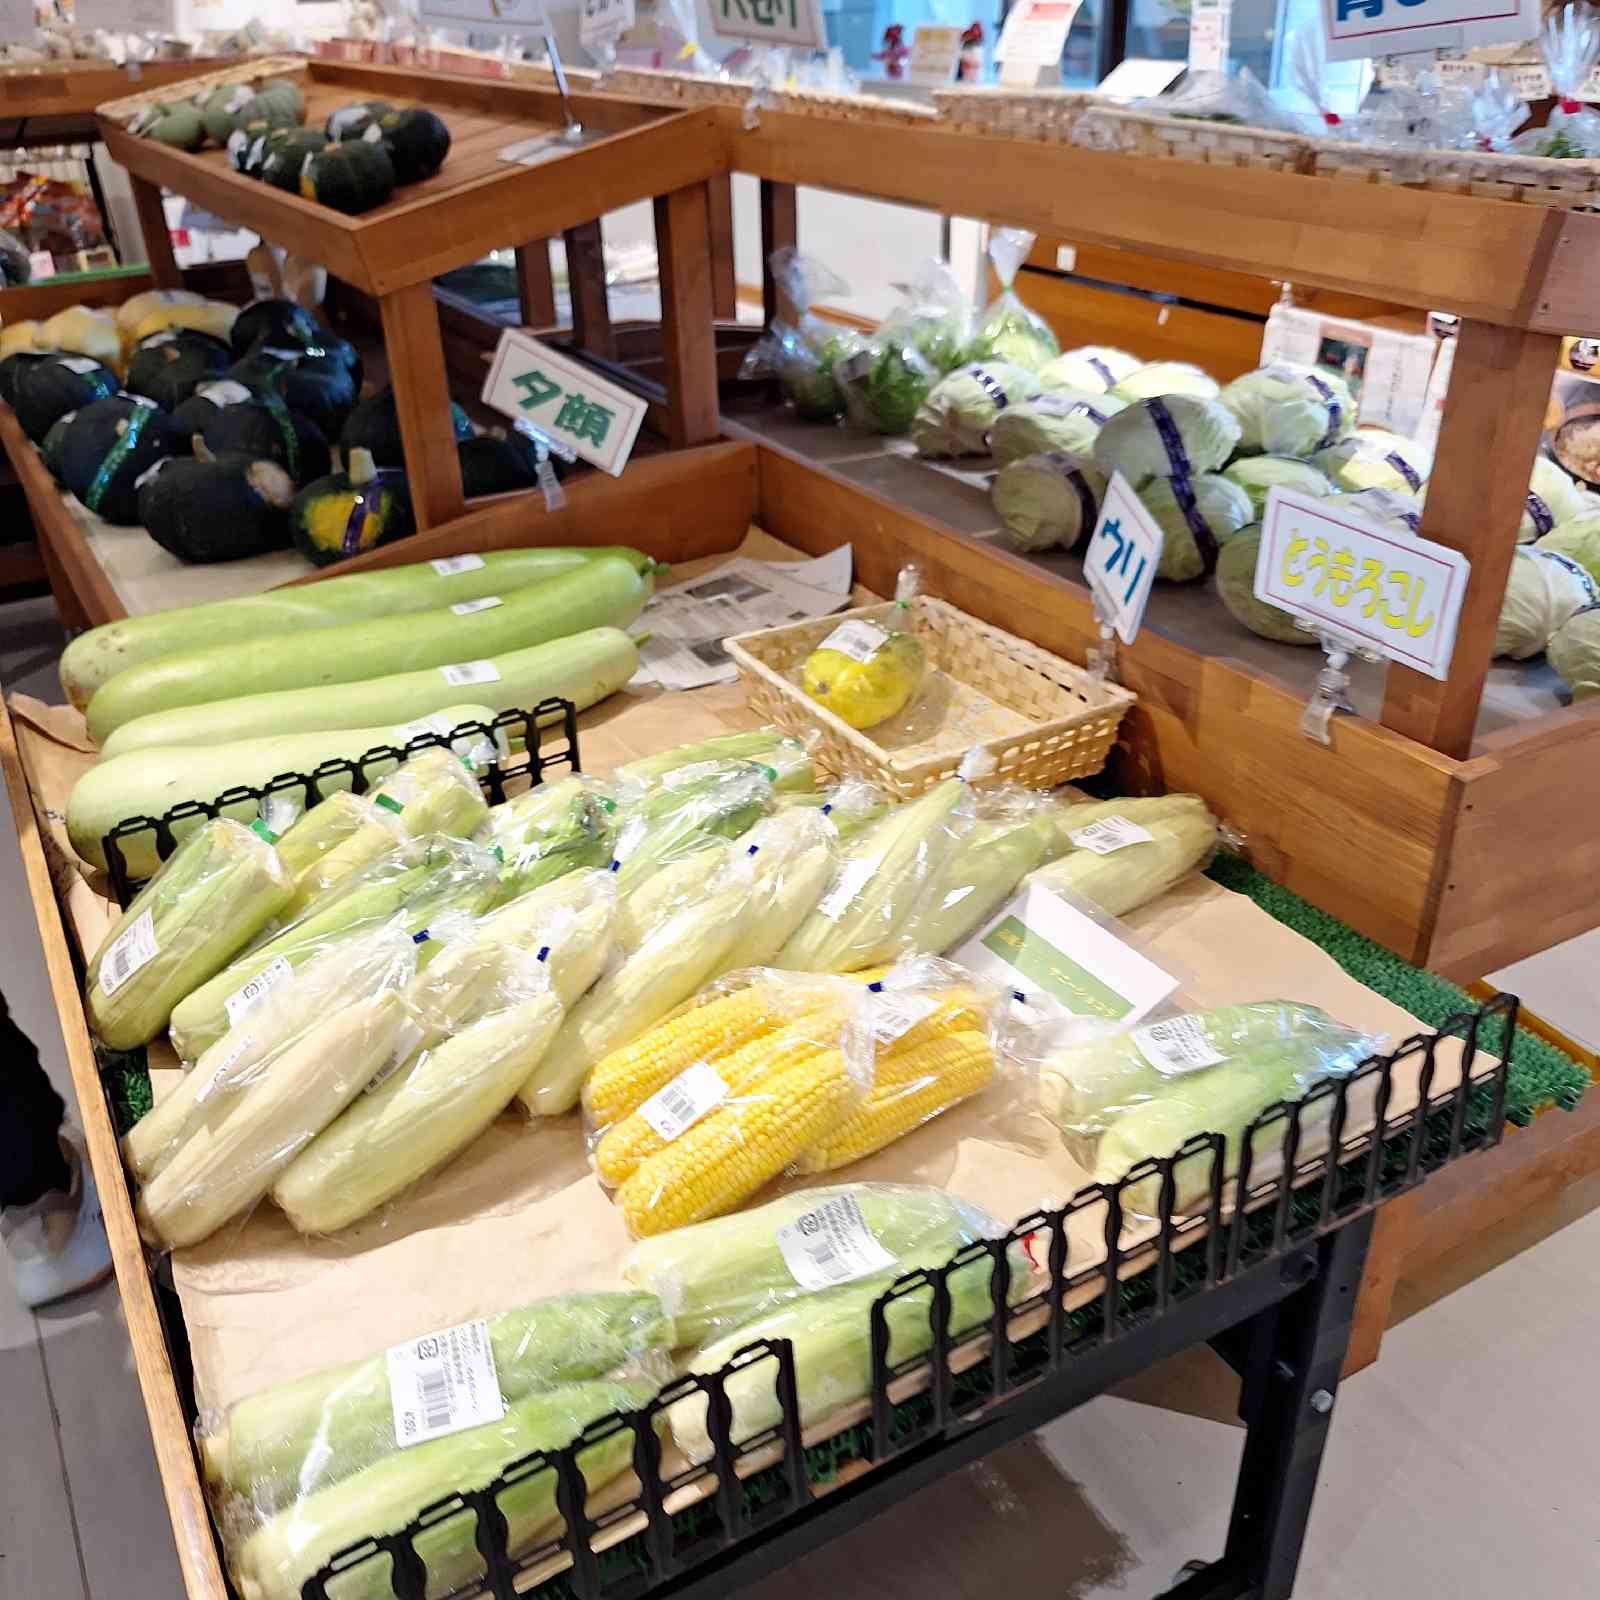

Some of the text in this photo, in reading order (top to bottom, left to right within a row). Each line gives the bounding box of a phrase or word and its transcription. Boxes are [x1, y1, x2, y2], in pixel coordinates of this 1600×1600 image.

[511, 370, 616, 449] 夕顔
[1101, 518, 1146, 605] ウリ
[1280, 527, 1436, 639] とうもろこし
